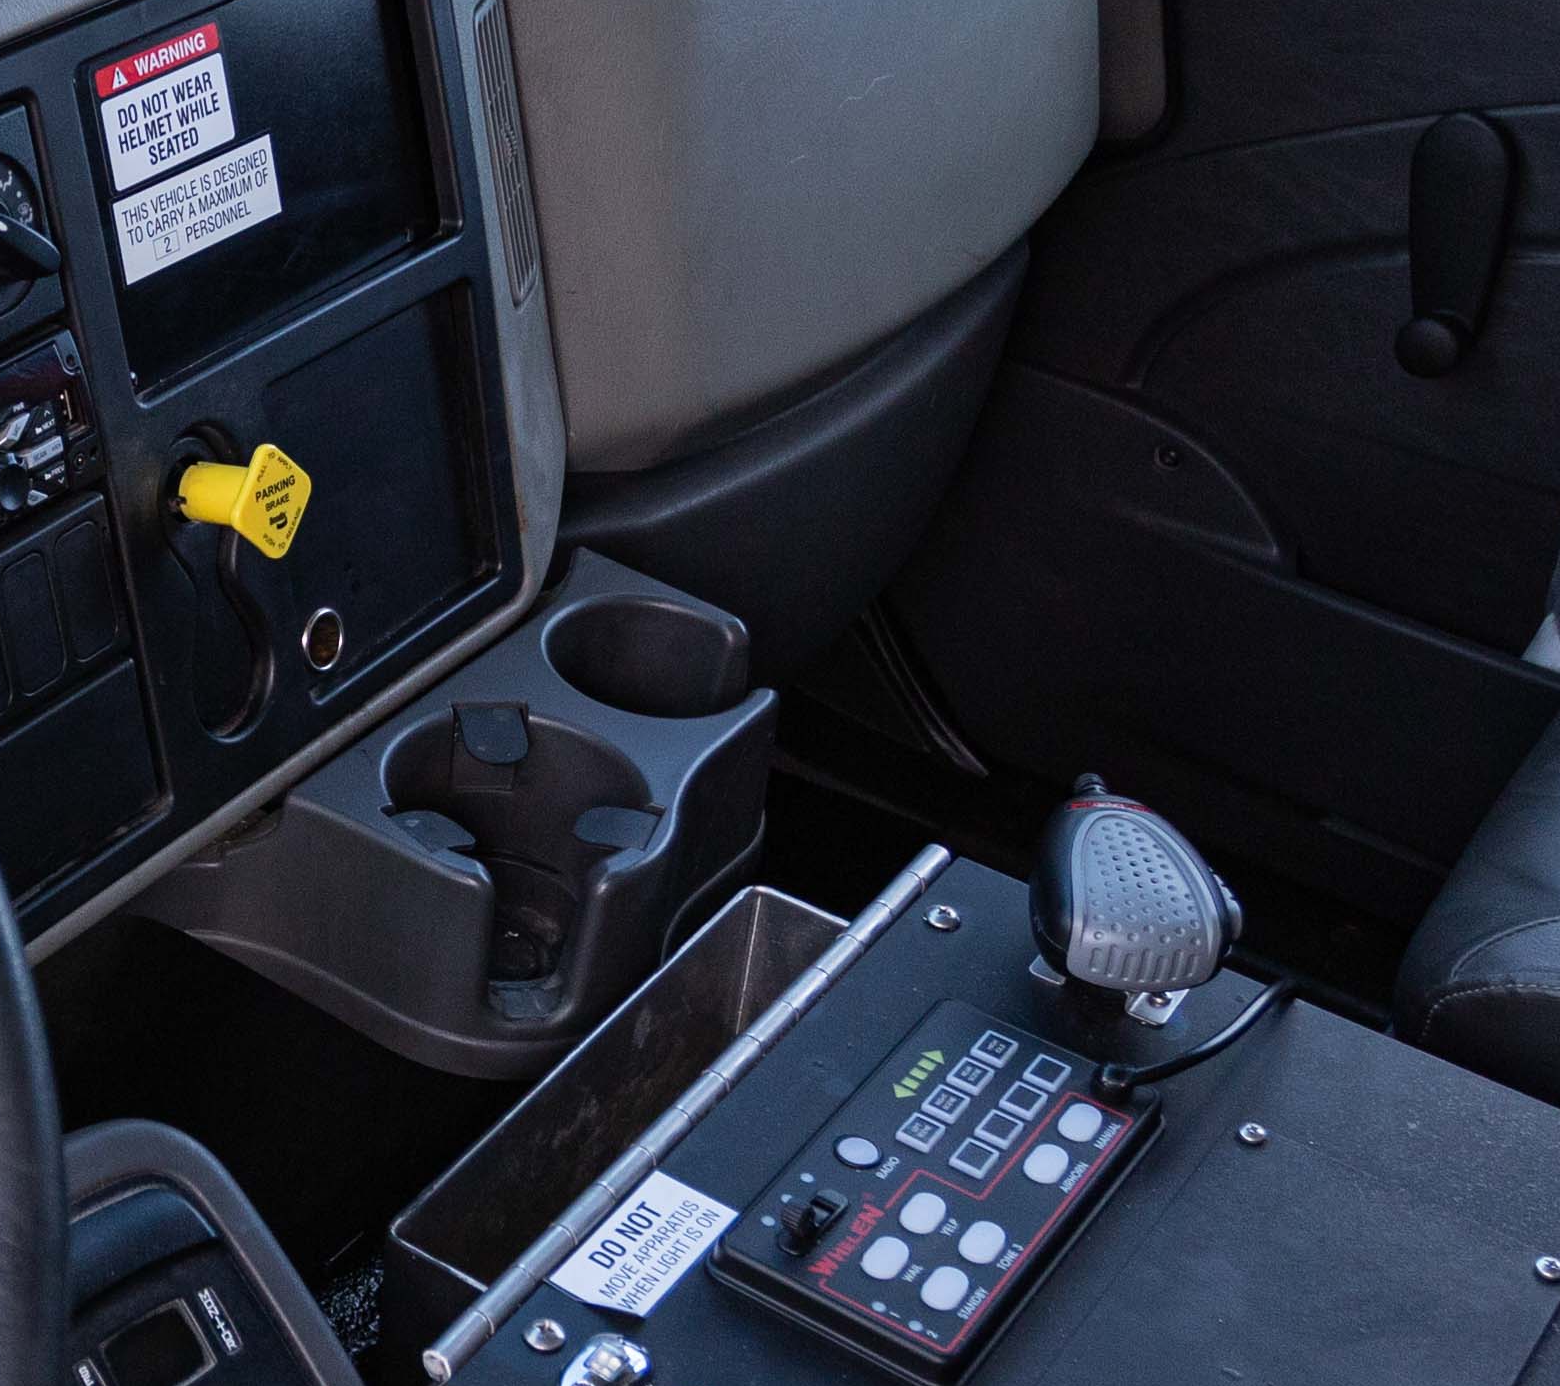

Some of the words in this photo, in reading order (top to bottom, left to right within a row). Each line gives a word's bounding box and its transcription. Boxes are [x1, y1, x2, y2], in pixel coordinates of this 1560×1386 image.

[134, 32, 206, 77] WARNING
[117, 101, 138, 129] DO
[142, 88, 170, 120] NOT
[171, 71, 213, 106] WEAR
[118, 112, 174, 154] HELMET
[175, 92, 221, 128] WHILE
[148, 126, 200, 166] SEATED
[122, 202, 150, 229] THIS
[149, 179, 198, 219] VEHICLE
[199, 173, 213, 193] IS
[212, 148, 268, 188] DESIGNED
[127, 225, 144, 247] TO
[146, 205, 186, 240] CARRY
[188, 204, 198, 222] A
[198, 177, 254, 218] MAXIMUM
[254, 168, 270, 190] OF
[163, 237, 173, 254] 2
[184, 200, 252, 245] PERSONNEL
[255, 474, 296, 503] PARKING
[265, 492, 290, 513] BRAKE
[1094, 1122, 1122, 1151] MANUAL
[876, 1155, 900, 1180] RADIO
[589, 1239, 620, 1271] DO
[621, 1201, 663, 1242] NOT
[809, 1199, 885, 1277] WHELEN
[940, 1217, 960, 1238] YELP
[599, 1257, 640, 1300] MOVE
[635, 1199, 700, 1265] APPARATUS
[618, 1273, 659, 1313] WHEN
[654, 1235, 688, 1279] LIGHT
[681, 1226, 701, 1246] IS
[700, 1208, 720, 1231] ON
[996, 1249, 1018, 1271] TONE
[902, 1262, 924, 1283] WAIL
[959, 1287, 989, 1320] STANDBY
[927, 1328, 938, 1340] 2
